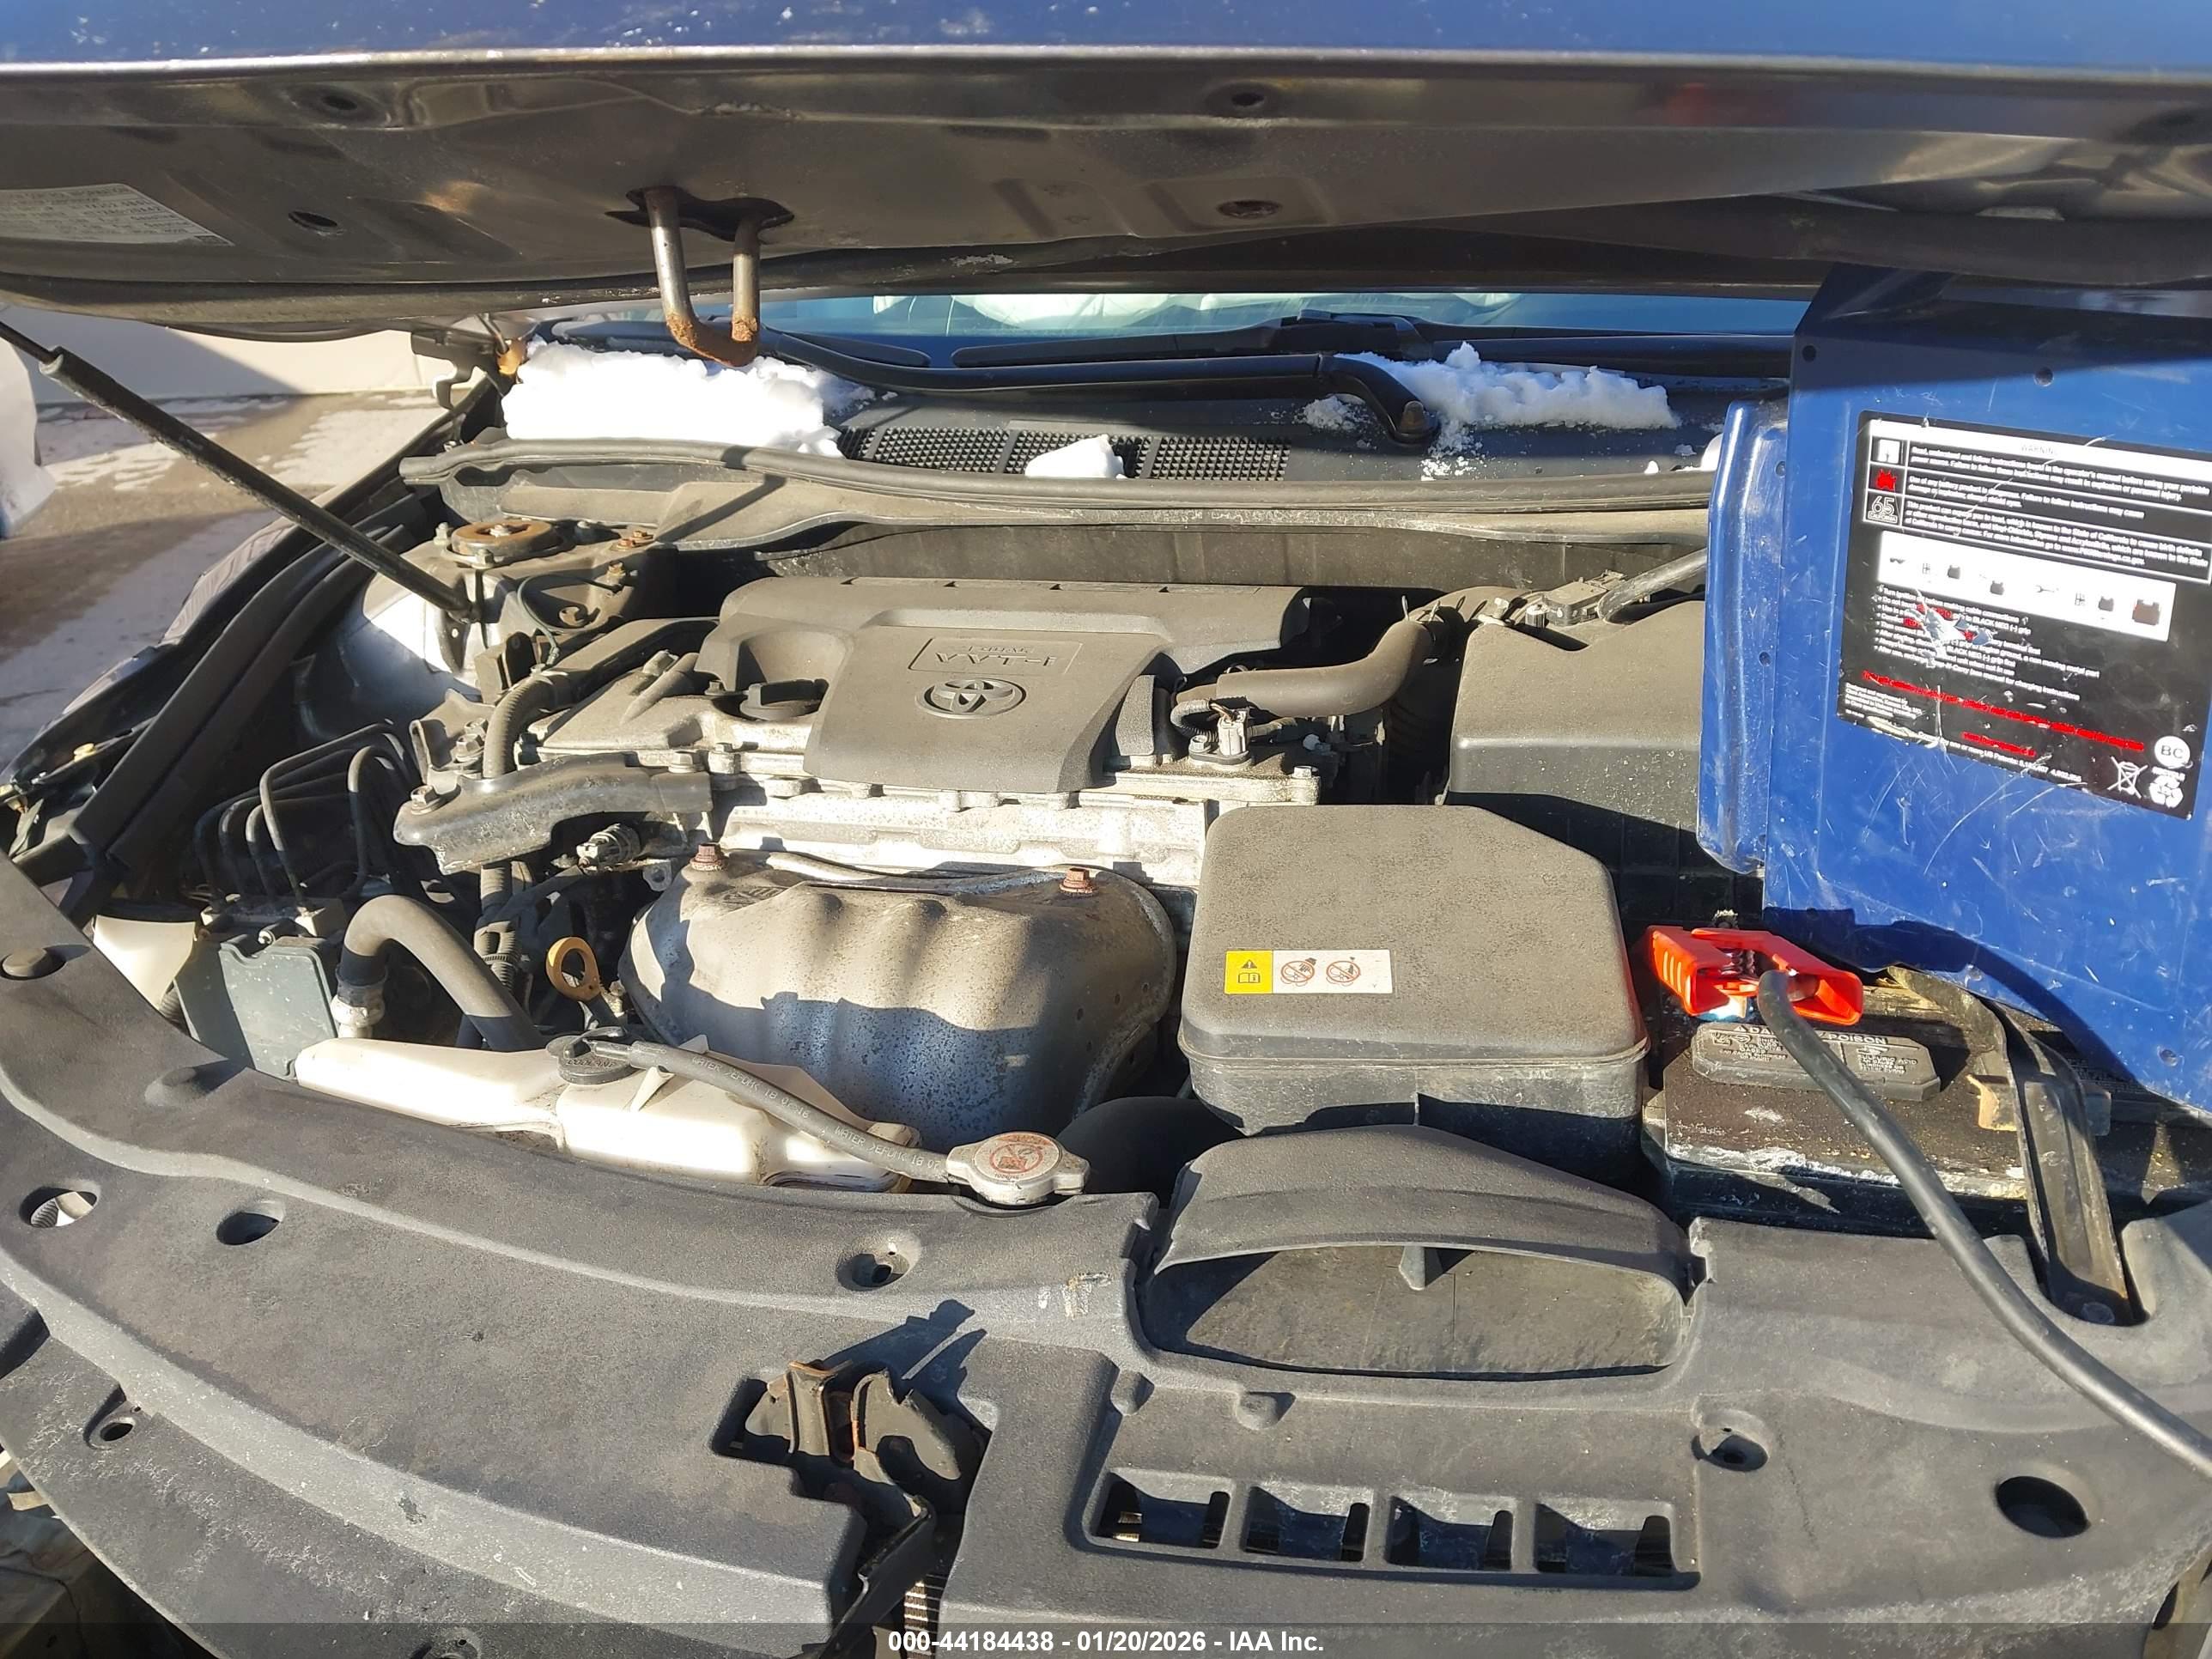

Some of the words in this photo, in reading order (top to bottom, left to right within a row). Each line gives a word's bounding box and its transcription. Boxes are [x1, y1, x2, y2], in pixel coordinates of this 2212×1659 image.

[1872, 495, 1895, 515] 65
[2160, 744, 2183, 759] BC
[1828, 1032, 1887, 1045] POISON
[692, 1055, 722, 1073] WATER
[834, 1126, 866, 1146] WATER
